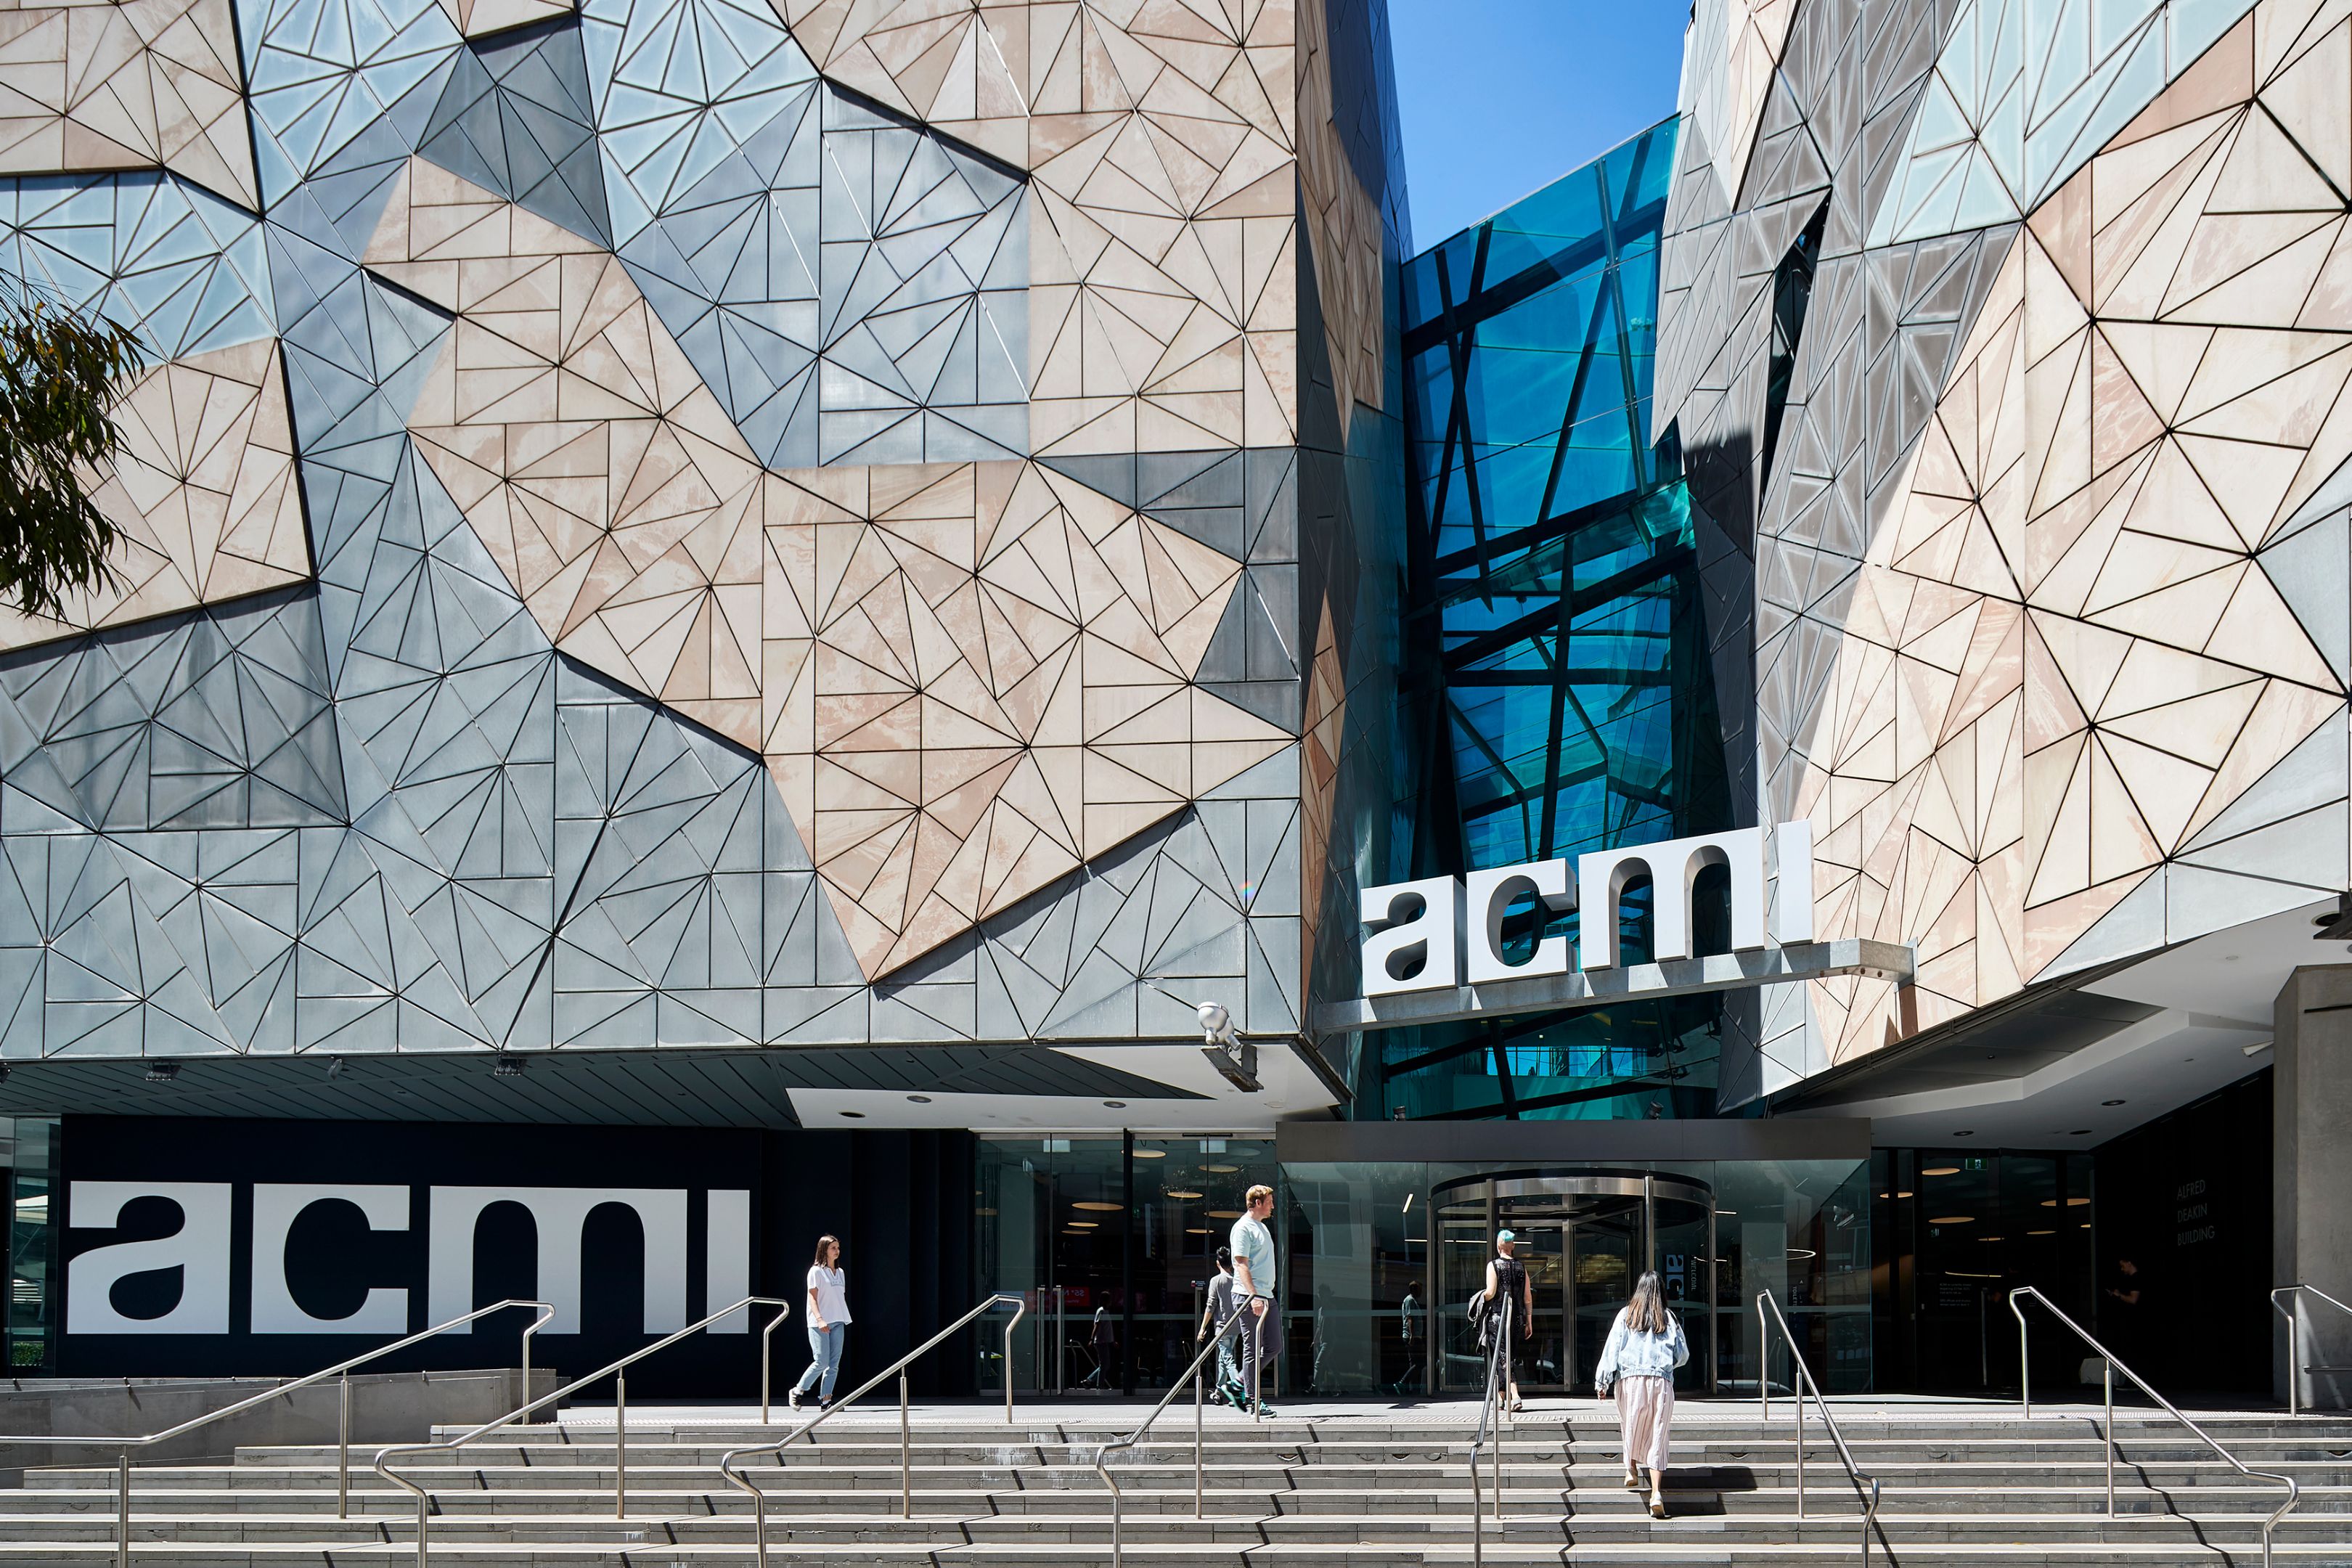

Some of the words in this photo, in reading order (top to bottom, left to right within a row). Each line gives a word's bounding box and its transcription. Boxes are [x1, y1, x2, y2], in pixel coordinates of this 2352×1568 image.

[1360, 820, 1813, 997] acmi
[2176, 1179, 2206, 1201] ALFRED
[2177, 1202, 2208, 1223] DEAKIN
[2177, 1225, 2216, 1246] BUILDING
[67, 1181, 750, 1334] acmi
